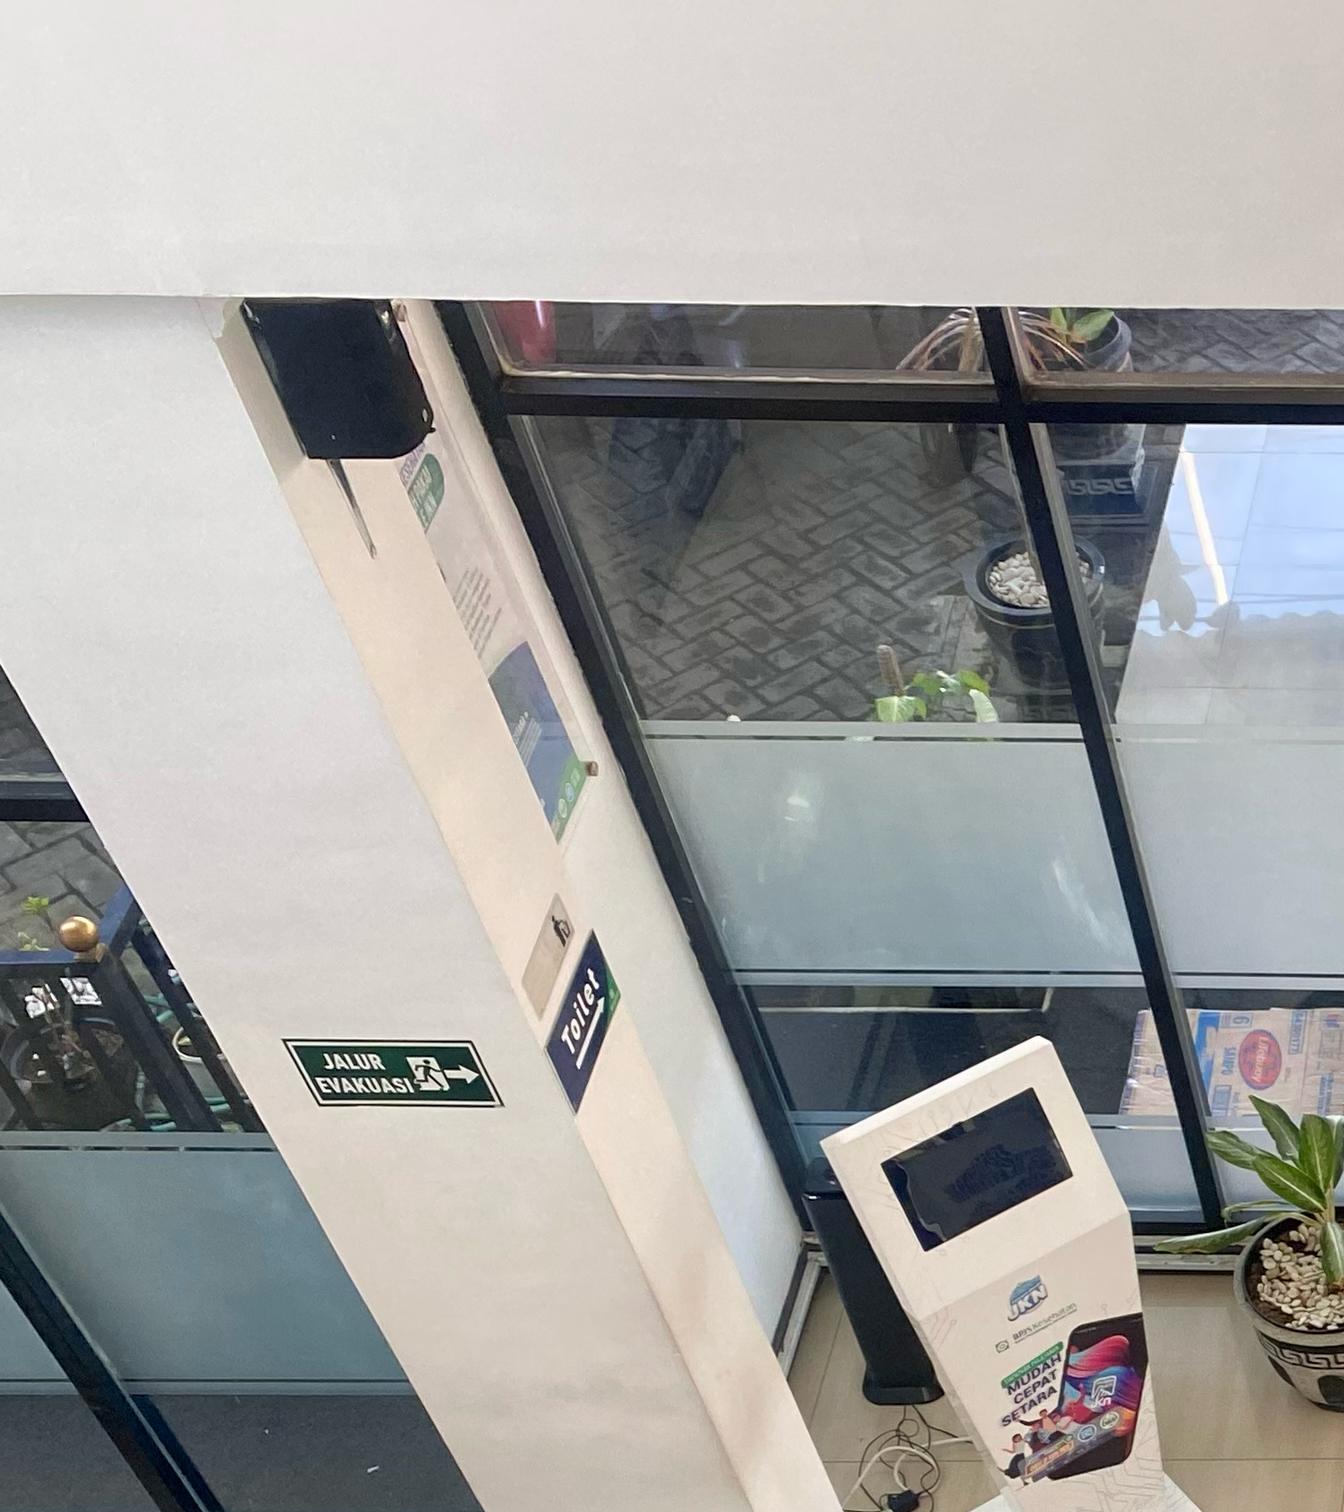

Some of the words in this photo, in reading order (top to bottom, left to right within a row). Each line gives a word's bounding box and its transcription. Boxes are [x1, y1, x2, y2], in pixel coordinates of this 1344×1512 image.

[561, 968, 600, 1055] Toilet
[323, 1053, 386, 1070] JALUR
[314, 1077, 415, 1093] EVAKUASI
[1008, 1283, 1048, 1321] JKN
[1007, 1353, 1061, 1395] MUDAH
[1014, 1369, 1057, 1404] CEPAT
[1002, 1386, 1057, 1427] SETARA
